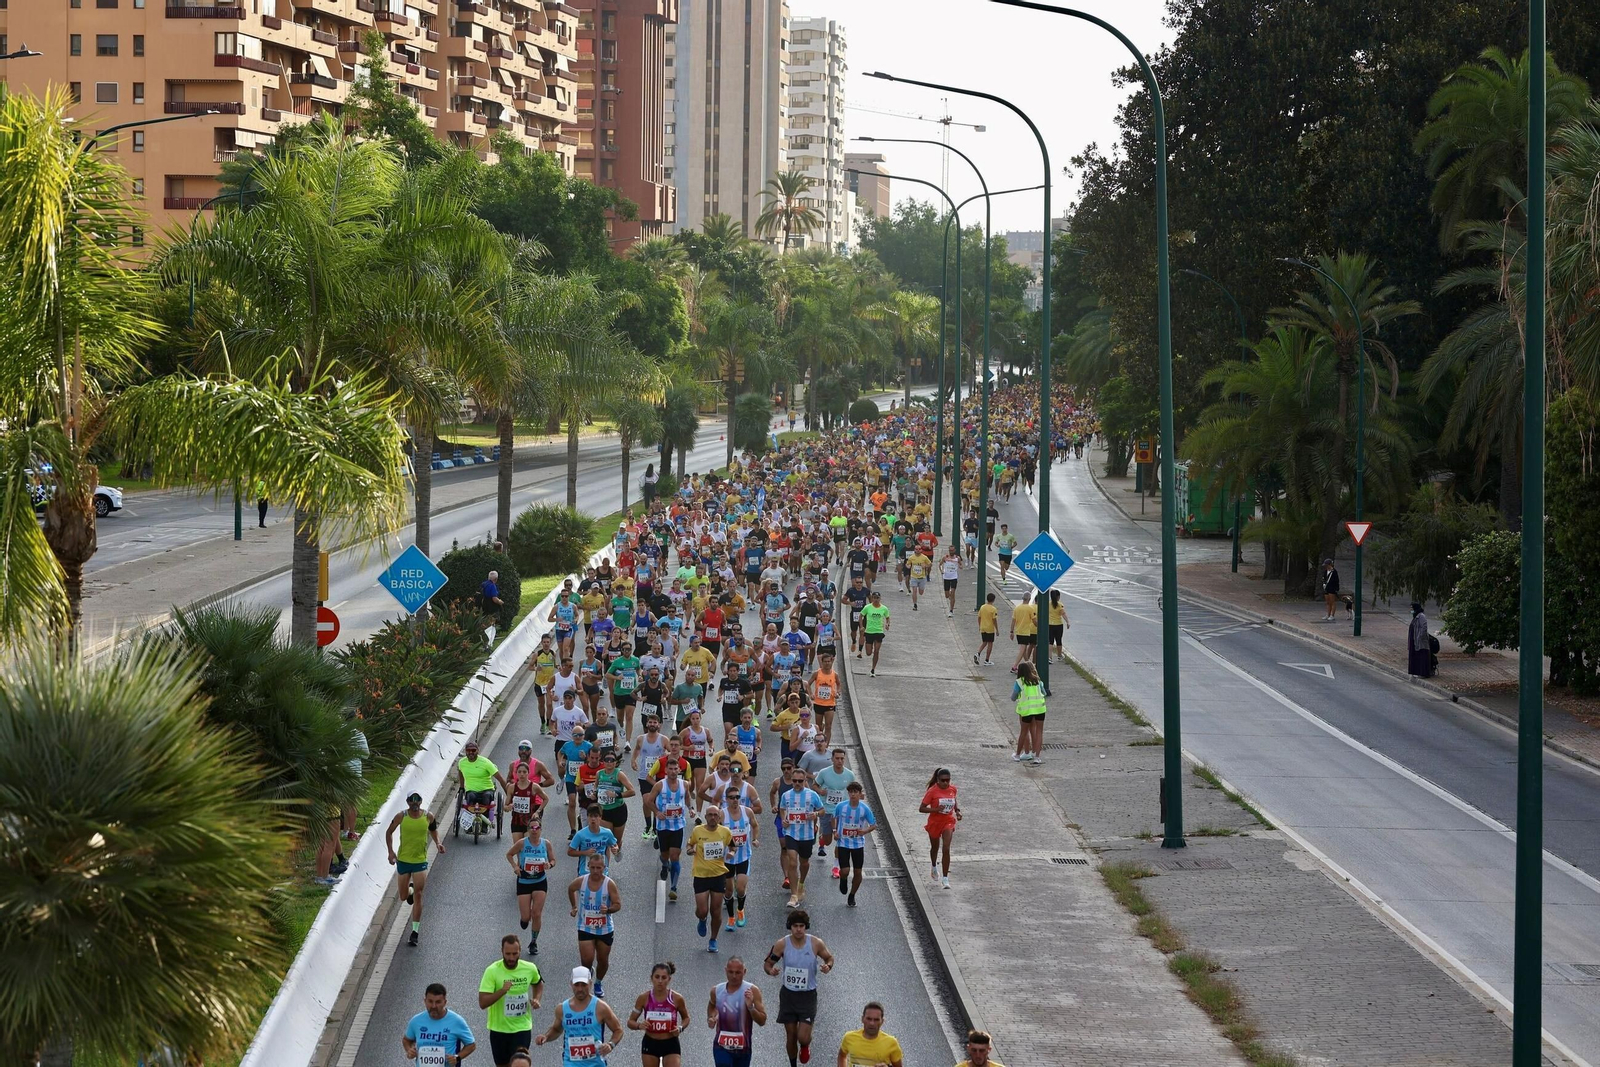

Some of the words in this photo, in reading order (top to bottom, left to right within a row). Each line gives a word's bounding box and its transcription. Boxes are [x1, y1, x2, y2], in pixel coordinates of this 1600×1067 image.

[1034, 552, 1054, 561] RED
[400, 569, 424, 578] RED
[786, 976, 806, 984] 8974
[506, 1002, 528, 1010] 10491
[566, 1016, 592, 1026] nerja
[652, 1022, 667, 1030] 104
[420, 1032, 448, 1042] nerja
[724, 1036, 740, 1046] 103
[574, 1046, 592, 1056] 216
[420, 1056, 444, 1064] 10900
